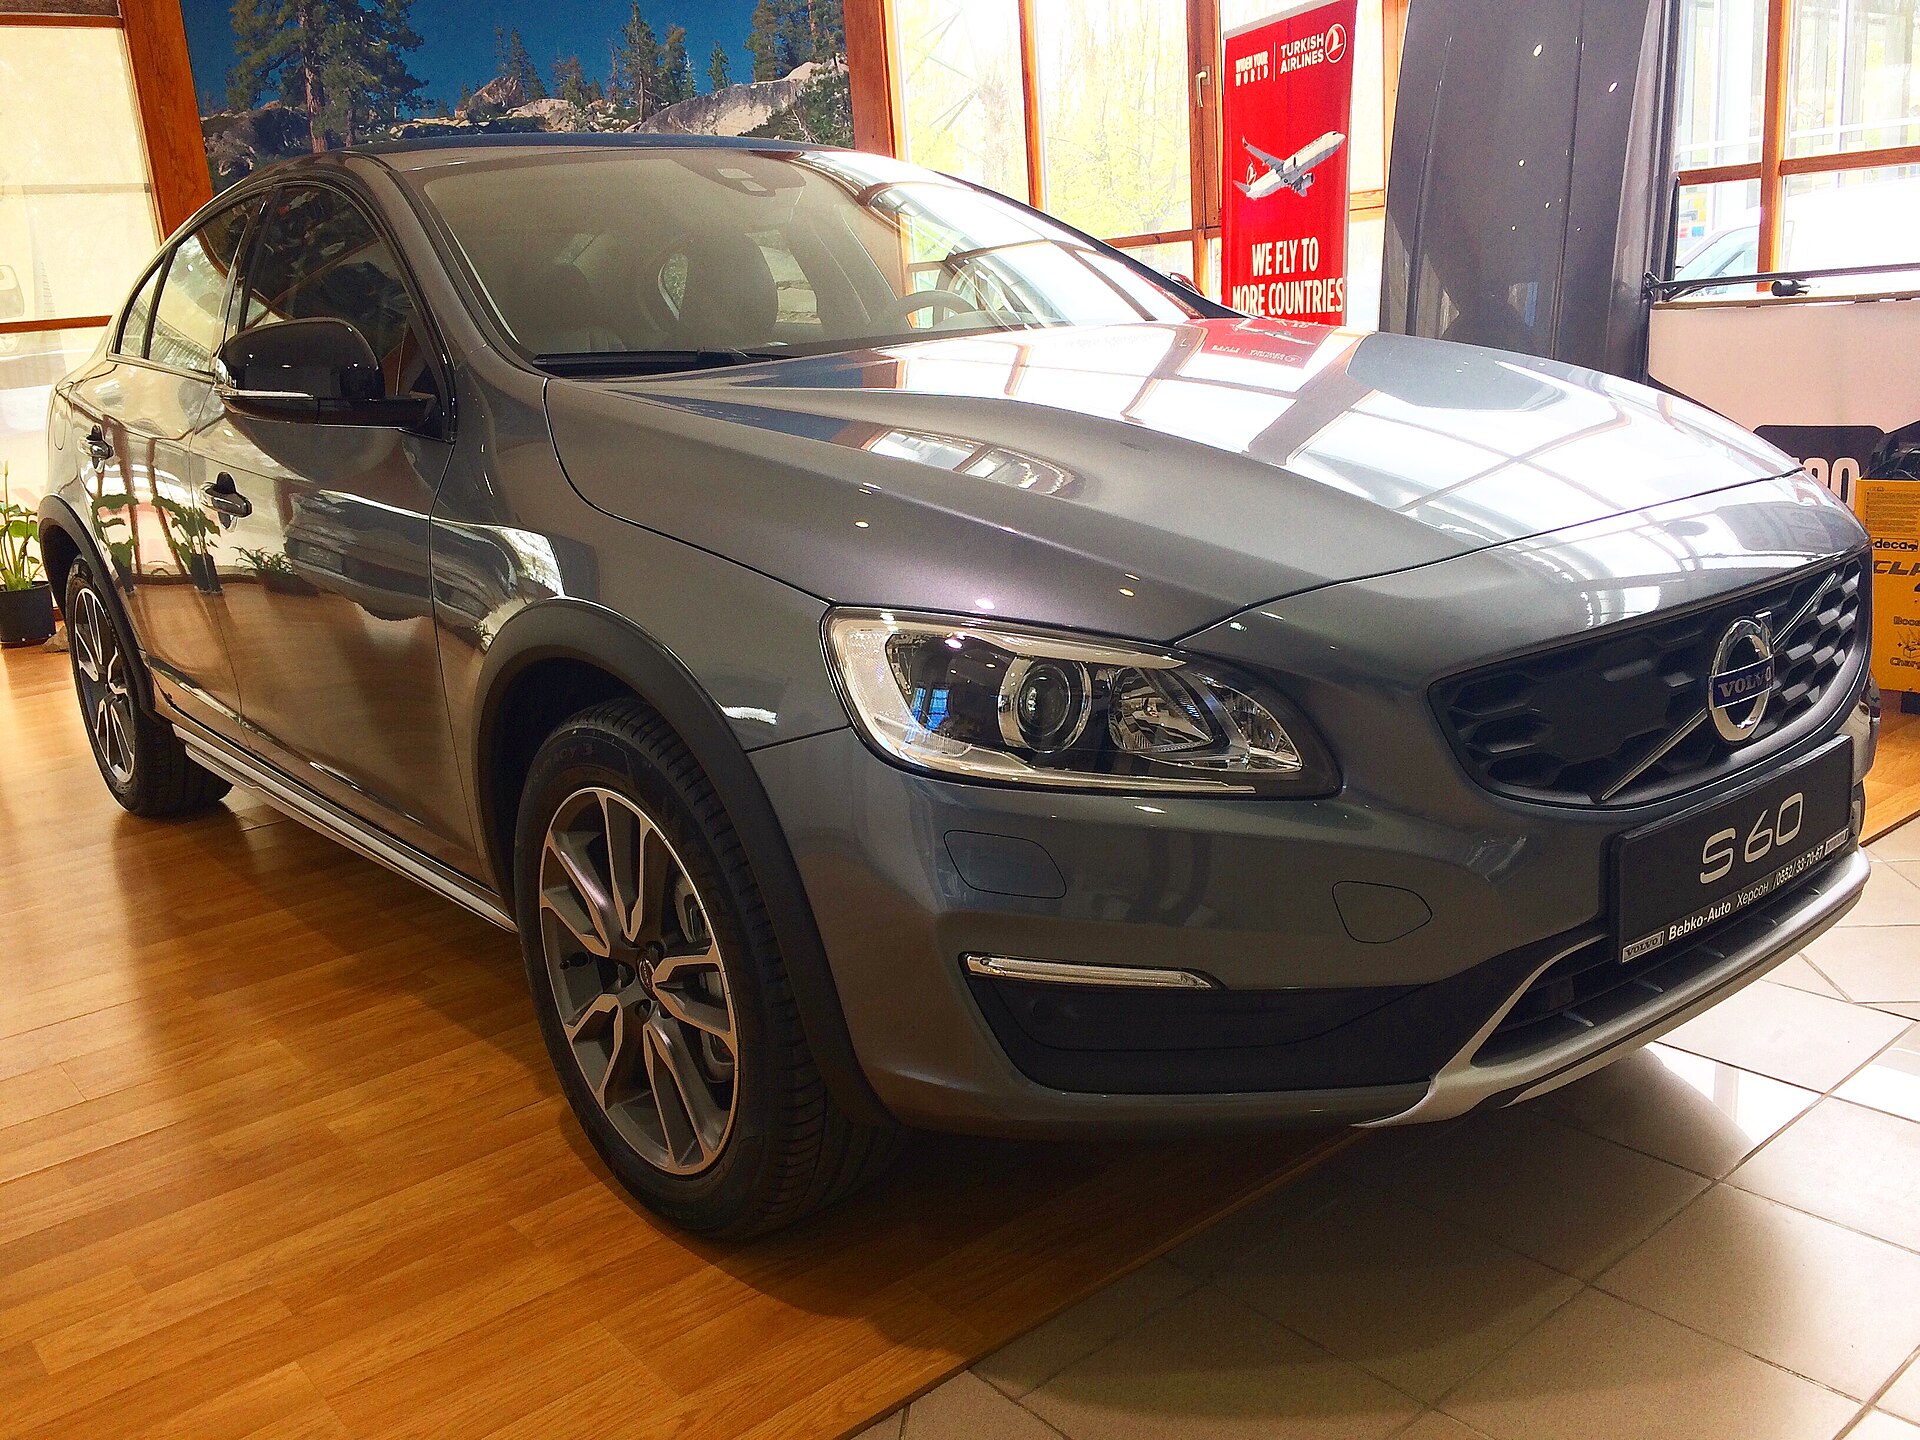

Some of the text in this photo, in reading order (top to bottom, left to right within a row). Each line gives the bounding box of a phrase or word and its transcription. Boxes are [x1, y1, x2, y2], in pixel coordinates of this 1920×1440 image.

[1280, 32, 1324, 59] TURKISH
[1280, 48, 1324, 75] AIRLINES
[1235, 64, 1269, 87] WORLD
[1251, 236, 1319, 277] WE FLY TO
[1232, 277, 1344, 317] MORE COUNTRIES
[1874, 538, 1908, 550] deca
[1717, 665, 1772, 698] VOLVO
[1700, 827, 1736, 884] S
[1744, 792, 1803, 863] 60
[1625, 937, 1659, 957] VOLVO
[1668, 901, 1732, 941] Bebko-Auto
[1736, 882, 1770, 909] Херсон
